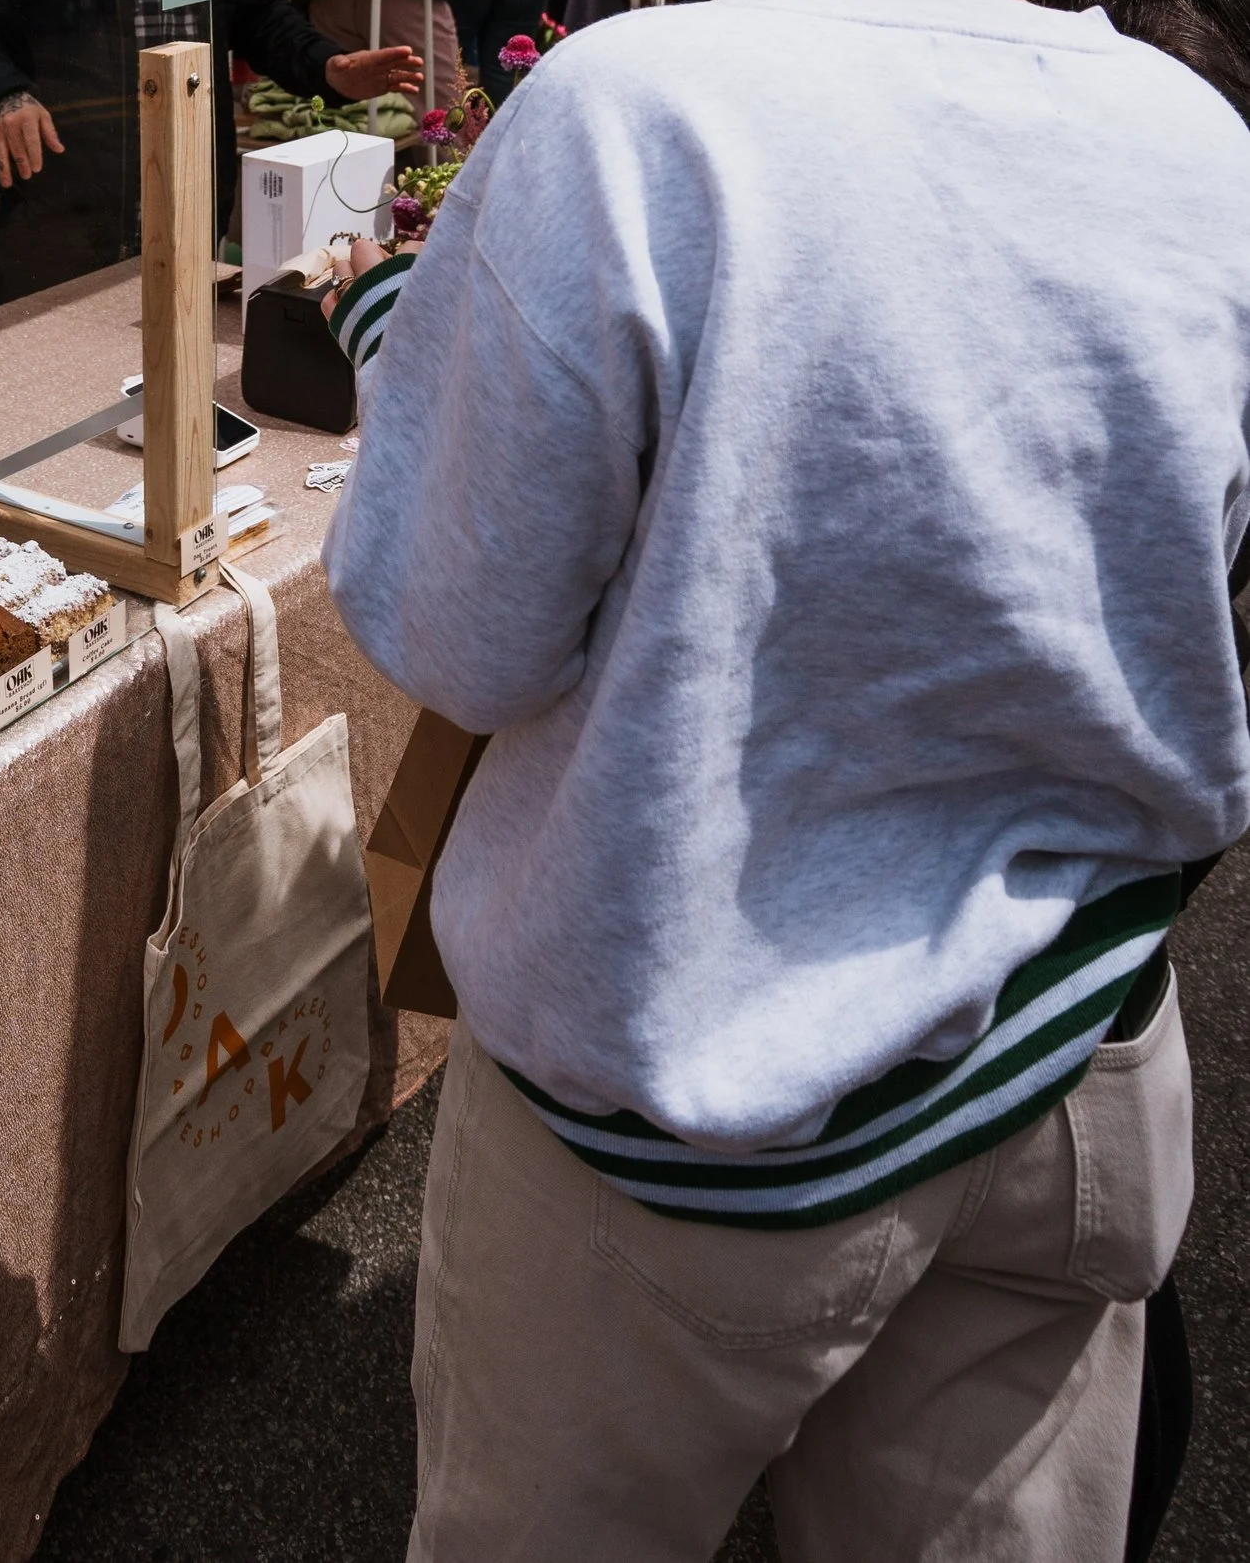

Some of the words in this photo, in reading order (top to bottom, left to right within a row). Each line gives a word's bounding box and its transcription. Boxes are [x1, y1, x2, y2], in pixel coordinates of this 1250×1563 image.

[194, 522, 214, 543] OAK
[84, 617, 108, 643] OAK
[6, 663, 32, 691] OAK
[8, 678, 33, 697] BAKESHOP
[20, 688, 36, 702] Bread
